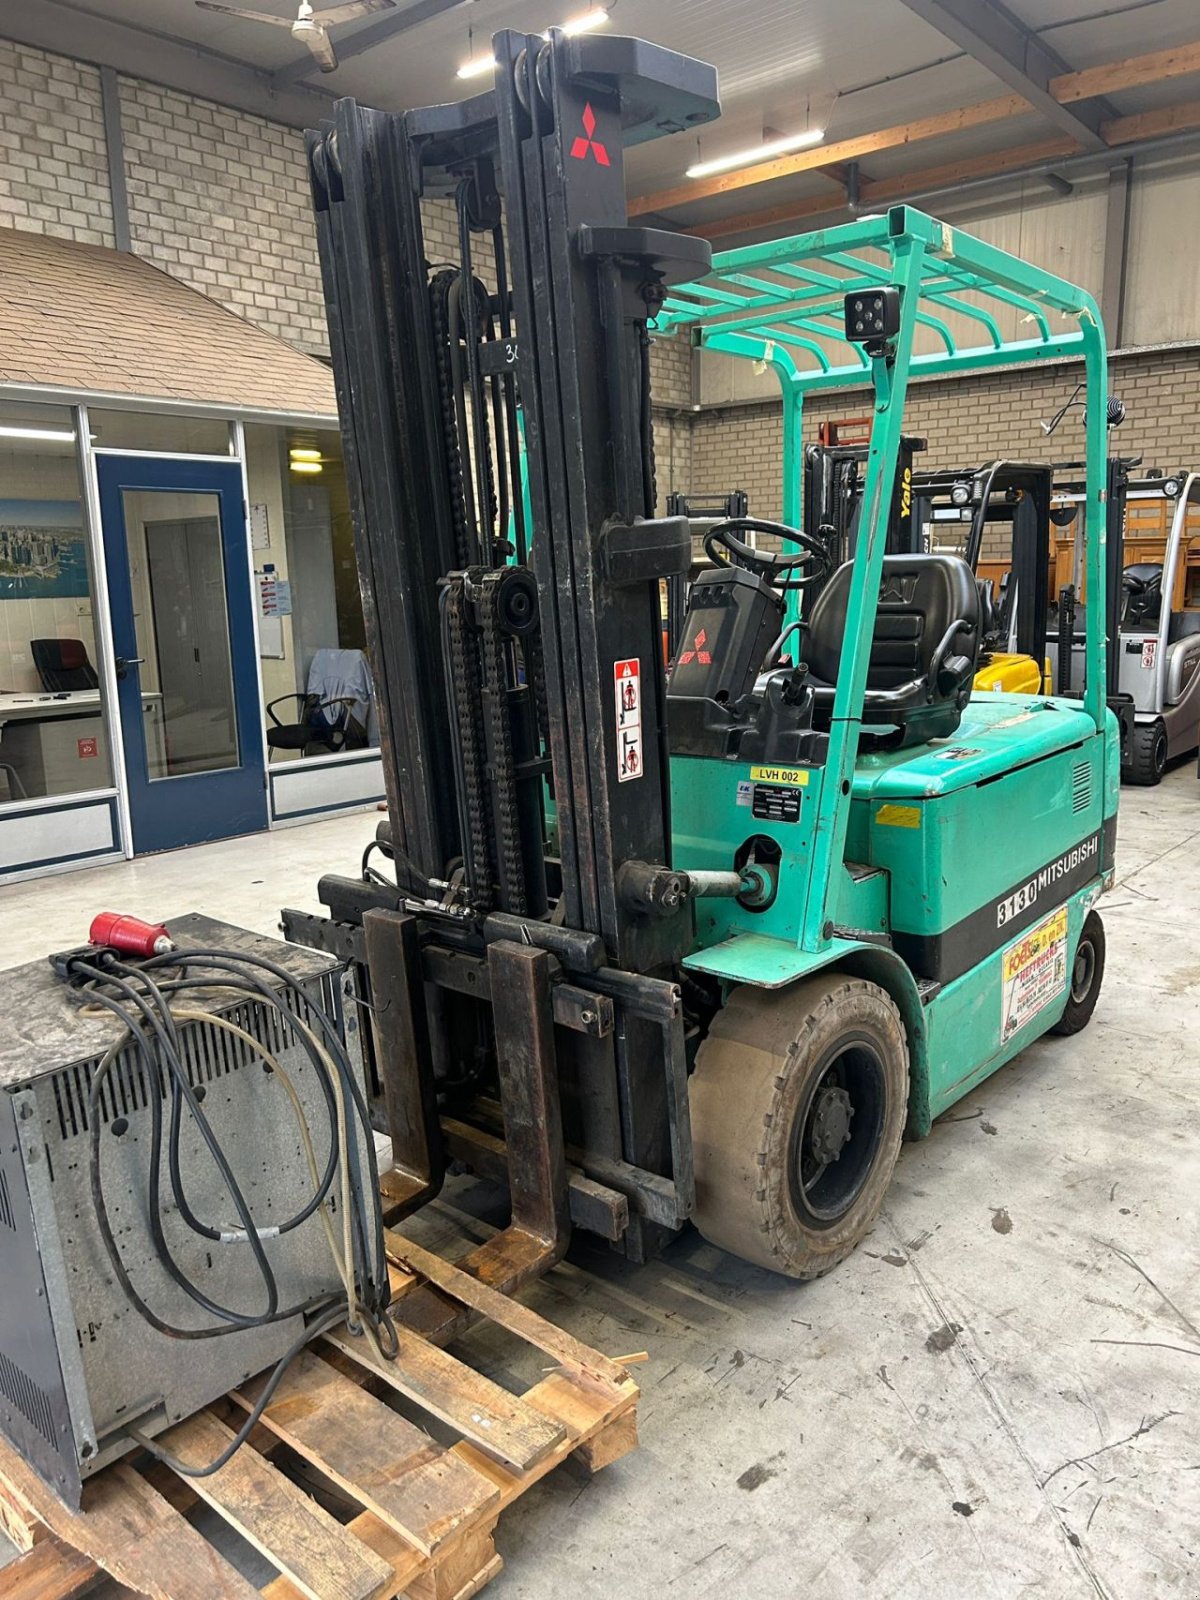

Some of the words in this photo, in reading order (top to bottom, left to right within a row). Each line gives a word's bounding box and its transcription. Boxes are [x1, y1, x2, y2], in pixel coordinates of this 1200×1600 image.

[901, 467, 911, 518] Yale
[760, 769, 779, 780] LVH
[782, 772, 799, 782] 002
[999, 881, 1036, 925] 3130
[1038, 836, 1098, 892] MITSUBISHI
